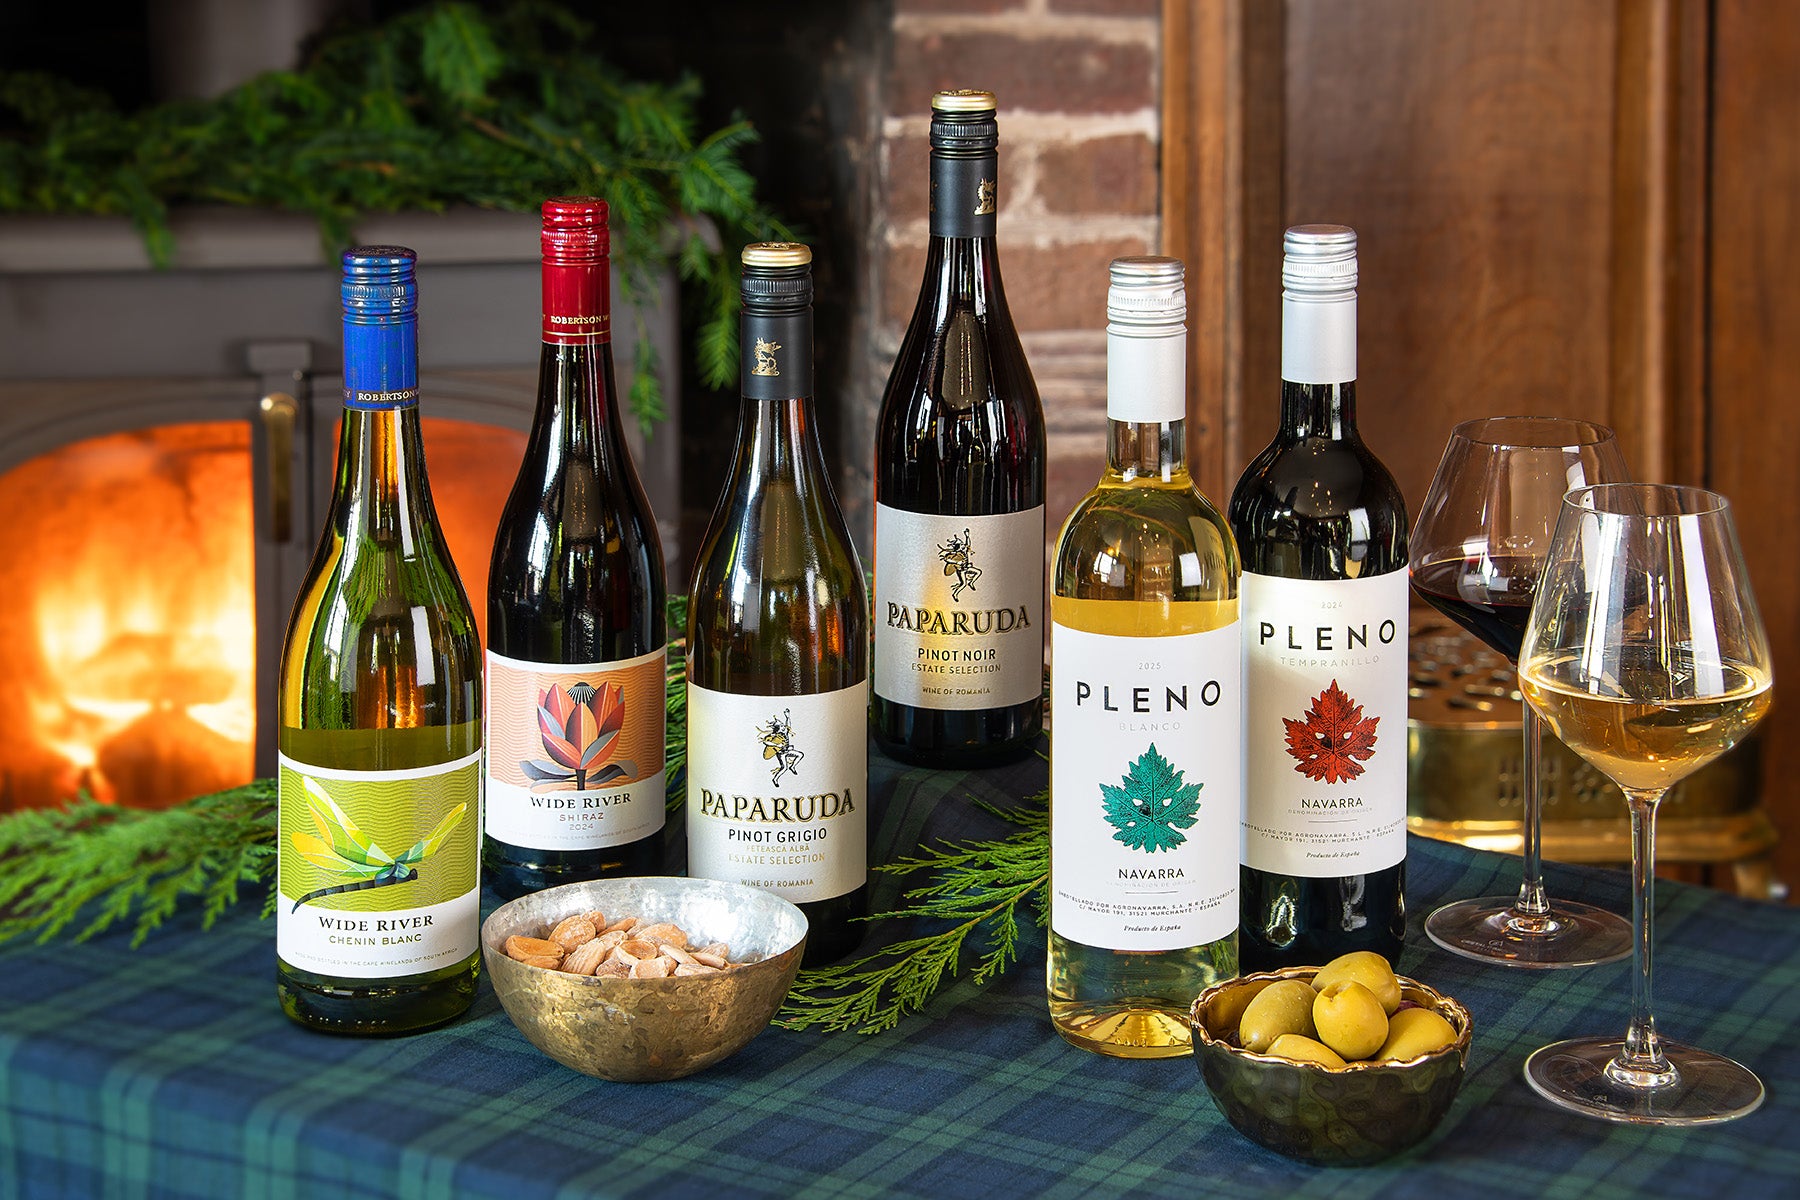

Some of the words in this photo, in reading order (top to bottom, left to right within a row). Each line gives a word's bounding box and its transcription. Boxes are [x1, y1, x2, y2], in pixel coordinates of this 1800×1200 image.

[550, 315, 602, 324] ROBERTSON
[358, 391, 415, 401] ROBERTSON
[887, 601, 1031, 636] PAPARUDA
[1260, 619, 1396, 650] PLENO
[918, 648, 959, 661] PINOT
[963, 649, 996, 661] NOIR
[1281, 655, 1380, 667] TEMPRANILLO
[912, 663, 945, 673] ESTATE
[949, 664, 1000, 674] SELECTION
[1077, 680, 1221, 712] PLENO
[1119, 722, 1181, 732] BLANCO
[530, 797, 576, 808] WIDE
[583, 793, 631, 808] RIVER
[700, 788, 855, 824] PAPARUDA
[1301, 797, 1363, 808] NAVARRA
[559, 813, 604, 821] SHIRAZ
[729, 829, 772, 842] PINOT
[776, 828, 827, 843] GRIGIO
[729, 855, 765, 865] ESTATE
[769, 853, 825, 865] SELECTION
[1118, 868, 1184, 879] NAVARRA
[740, 879, 761, 887] WINE
[777, 879, 814, 887] ROMANIA
[318, 916, 368, 931] WIDE
[376, 915, 434, 931] RIVER
[329, 935, 376, 945] CHENIN
[382, 933, 422, 945] BLANC
